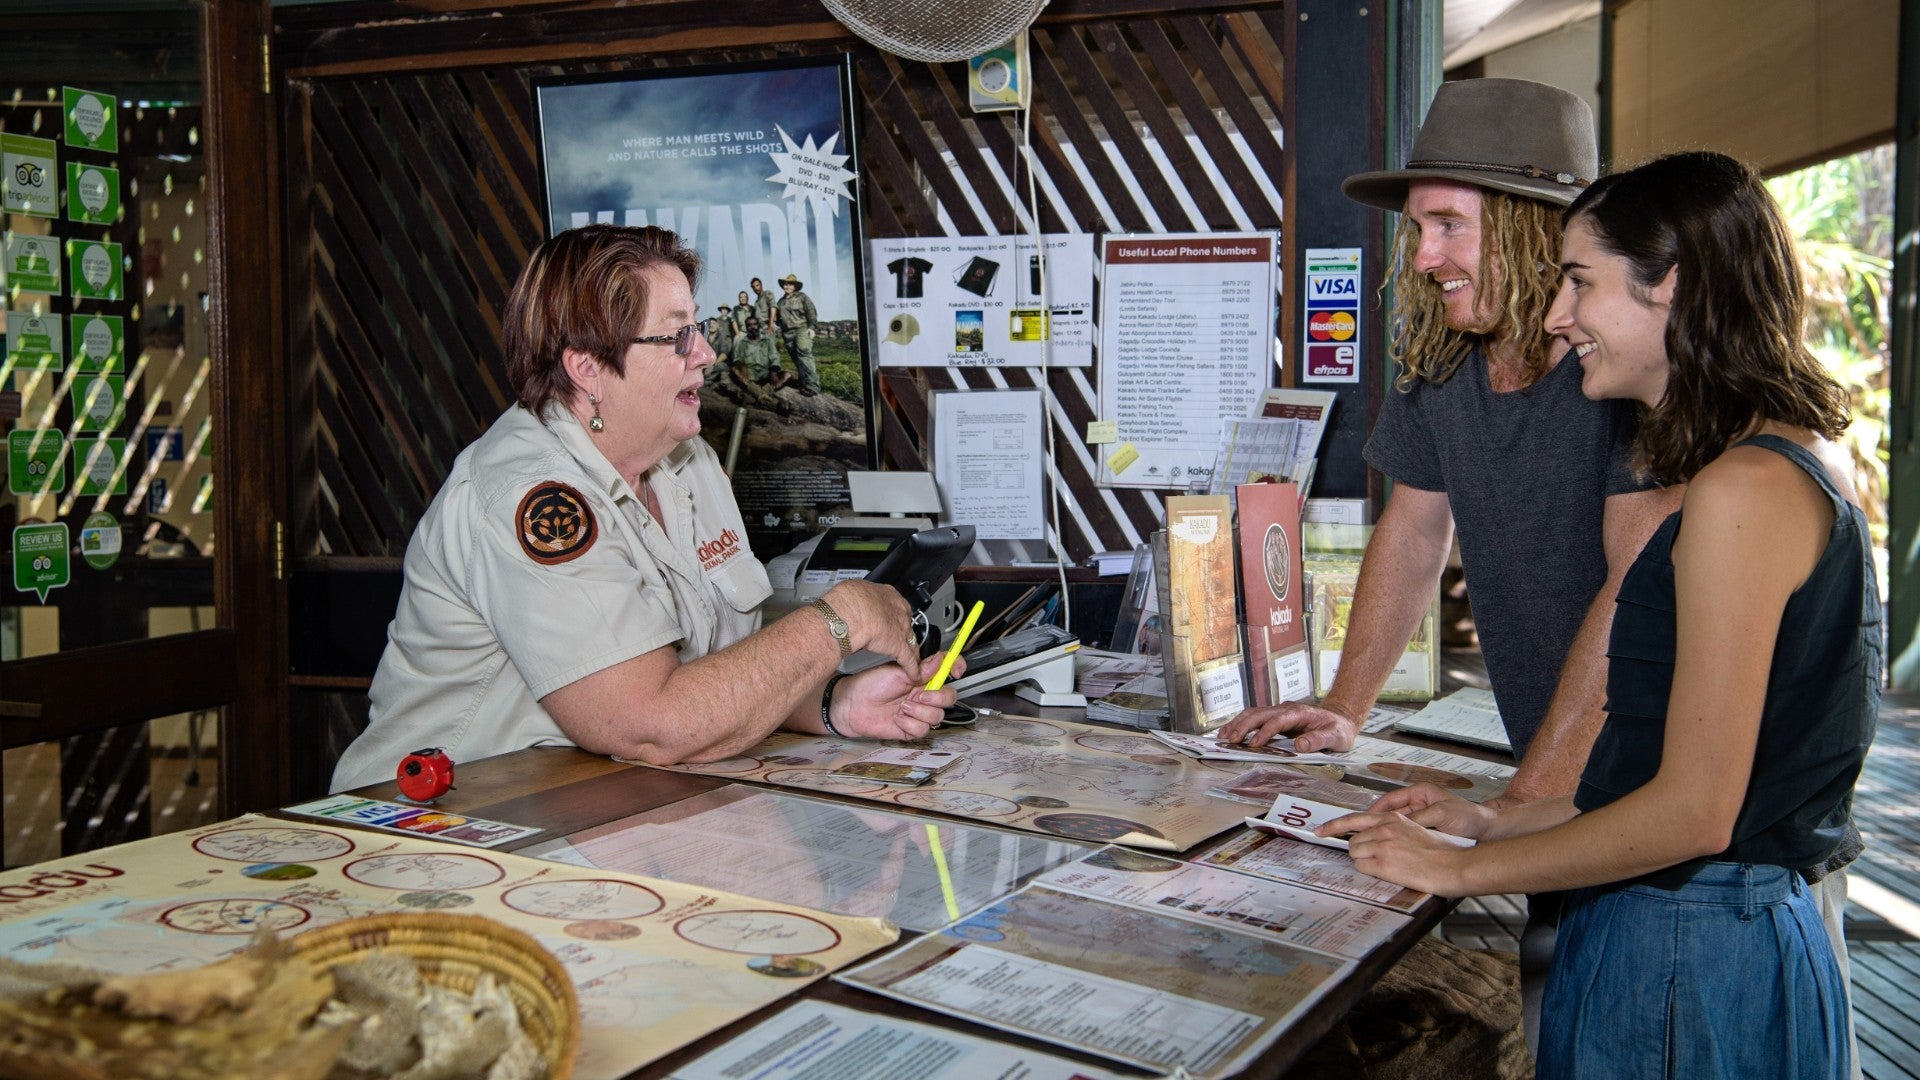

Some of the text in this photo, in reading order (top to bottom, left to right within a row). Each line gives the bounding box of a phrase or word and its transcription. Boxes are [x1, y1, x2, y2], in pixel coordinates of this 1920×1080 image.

[623, 130, 764, 149] WHERE MAN MEETS WILD
[608, 142, 782, 162] AND NATURE CALLS THE SHOTS
[791, 153, 841, 172] ON SALE NOW!
[798, 167, 830, 181] DVD $30
[788, 178, 836, 196] BLU-RAY $32
[8, 189, 50, 204] tripadvisor
[1118, 246, 1257, 258] Useful Local Phone Numbers
[1314, 279, 1356, 294] VISA
[1310, 322, 1354, 331] MasterCard
[1335, 346, 1353, 364] e
[1314, 365, 1348, 375] eftpos
[1118, 436, 1128, 444] Top
[20, 533, 63, 546] REVIEW US
[722, 545, 741, 561] PARK
[1270, 606, 1292, 626] kakadu
[349, 805, 408, 820] VISA
[405, 816, 459, 831] MasterCard
[478, 829, 517, 842] eftpos
